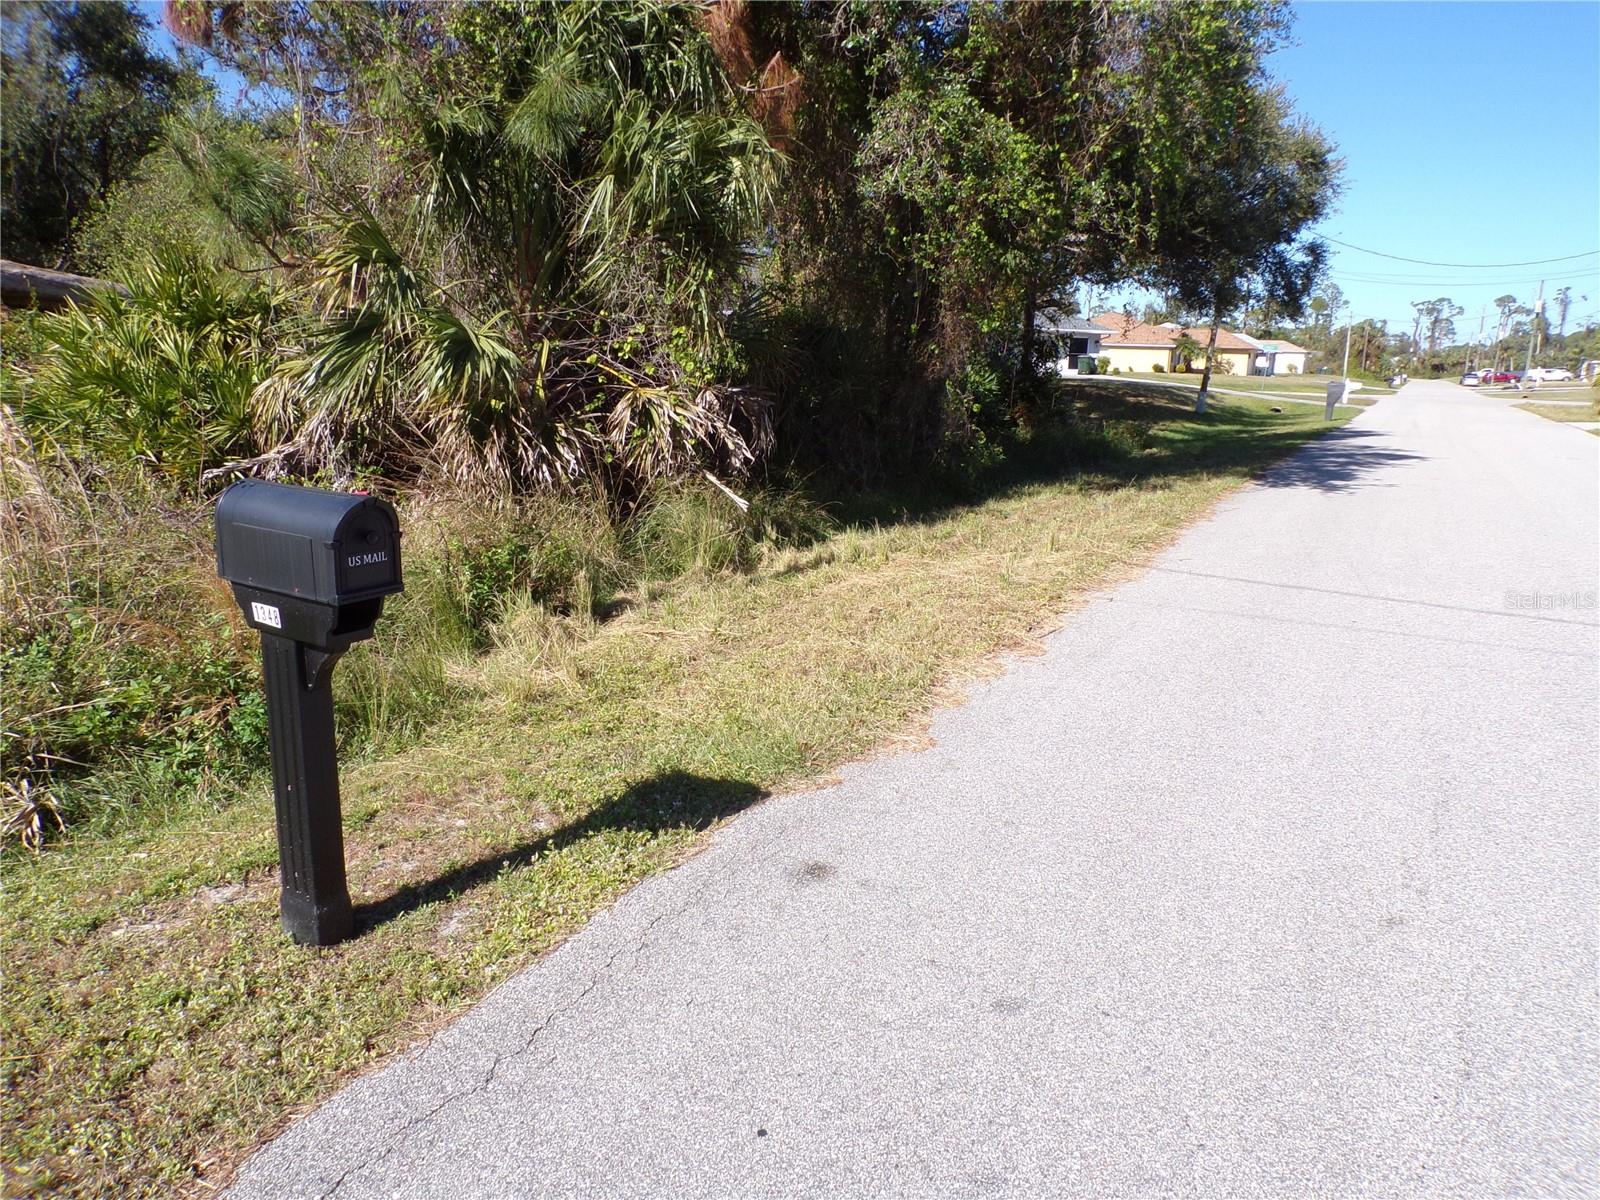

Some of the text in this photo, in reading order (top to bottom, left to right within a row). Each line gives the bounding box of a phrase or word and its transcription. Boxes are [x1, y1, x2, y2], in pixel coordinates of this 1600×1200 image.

[348, 551, 388, 567] US MAIL
[254, 604, 280, 626] 1348
